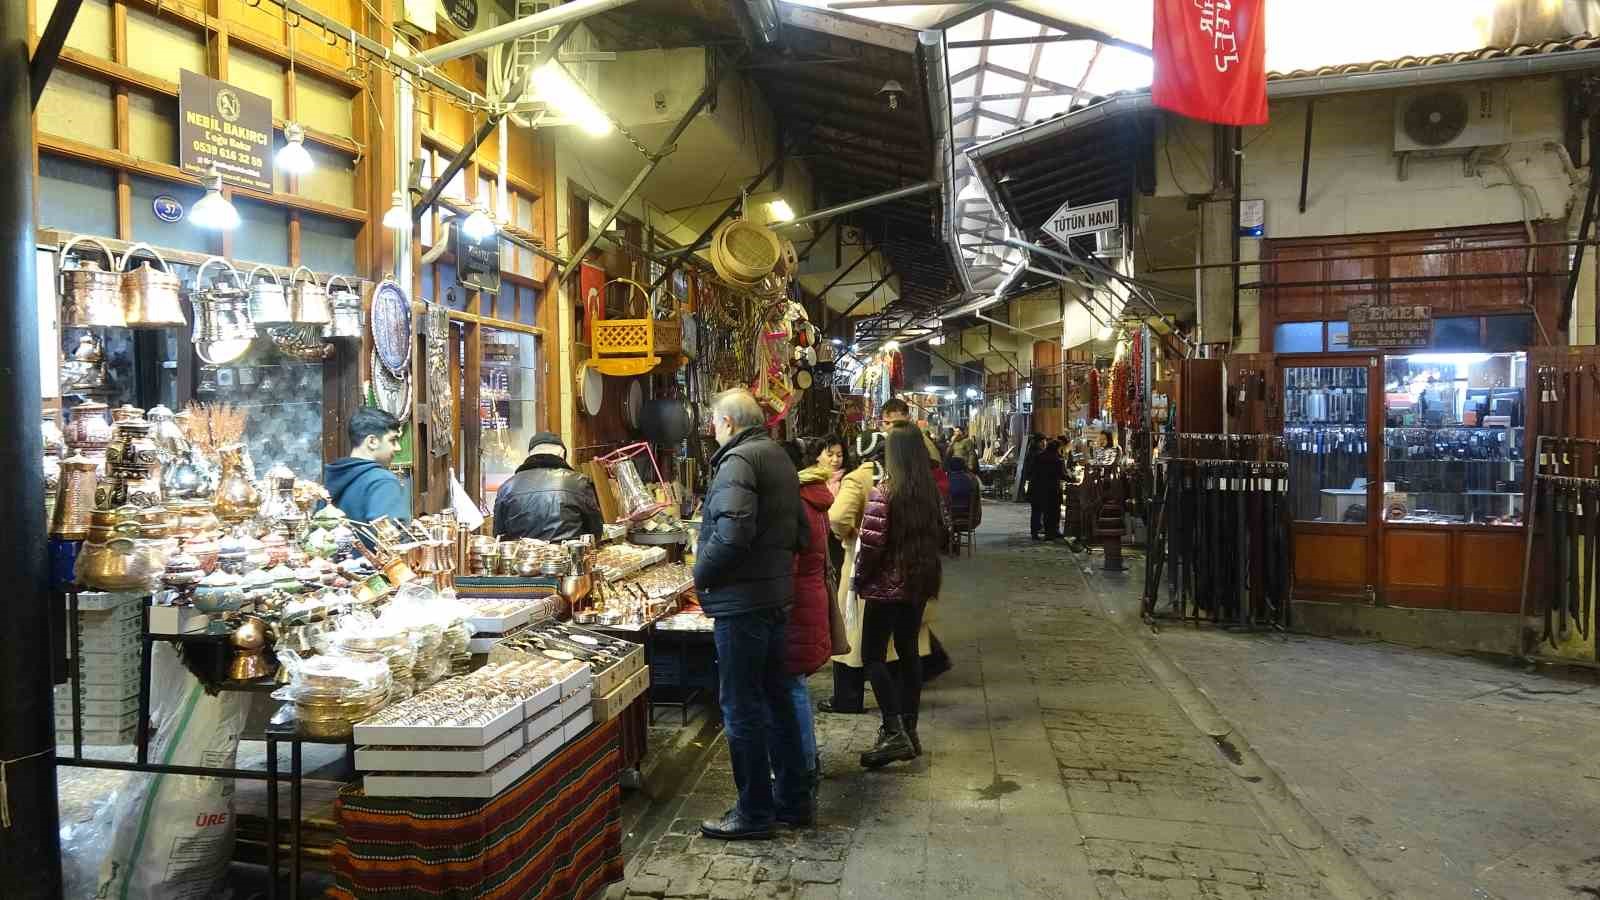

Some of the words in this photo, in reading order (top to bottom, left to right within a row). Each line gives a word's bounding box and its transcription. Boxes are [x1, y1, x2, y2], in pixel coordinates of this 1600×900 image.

[223, 121, 267, 146] BAKIRCI
[1054, 213, 1085, 233] TÜTÜN
[1088, 209, 1113, 228] HANI
